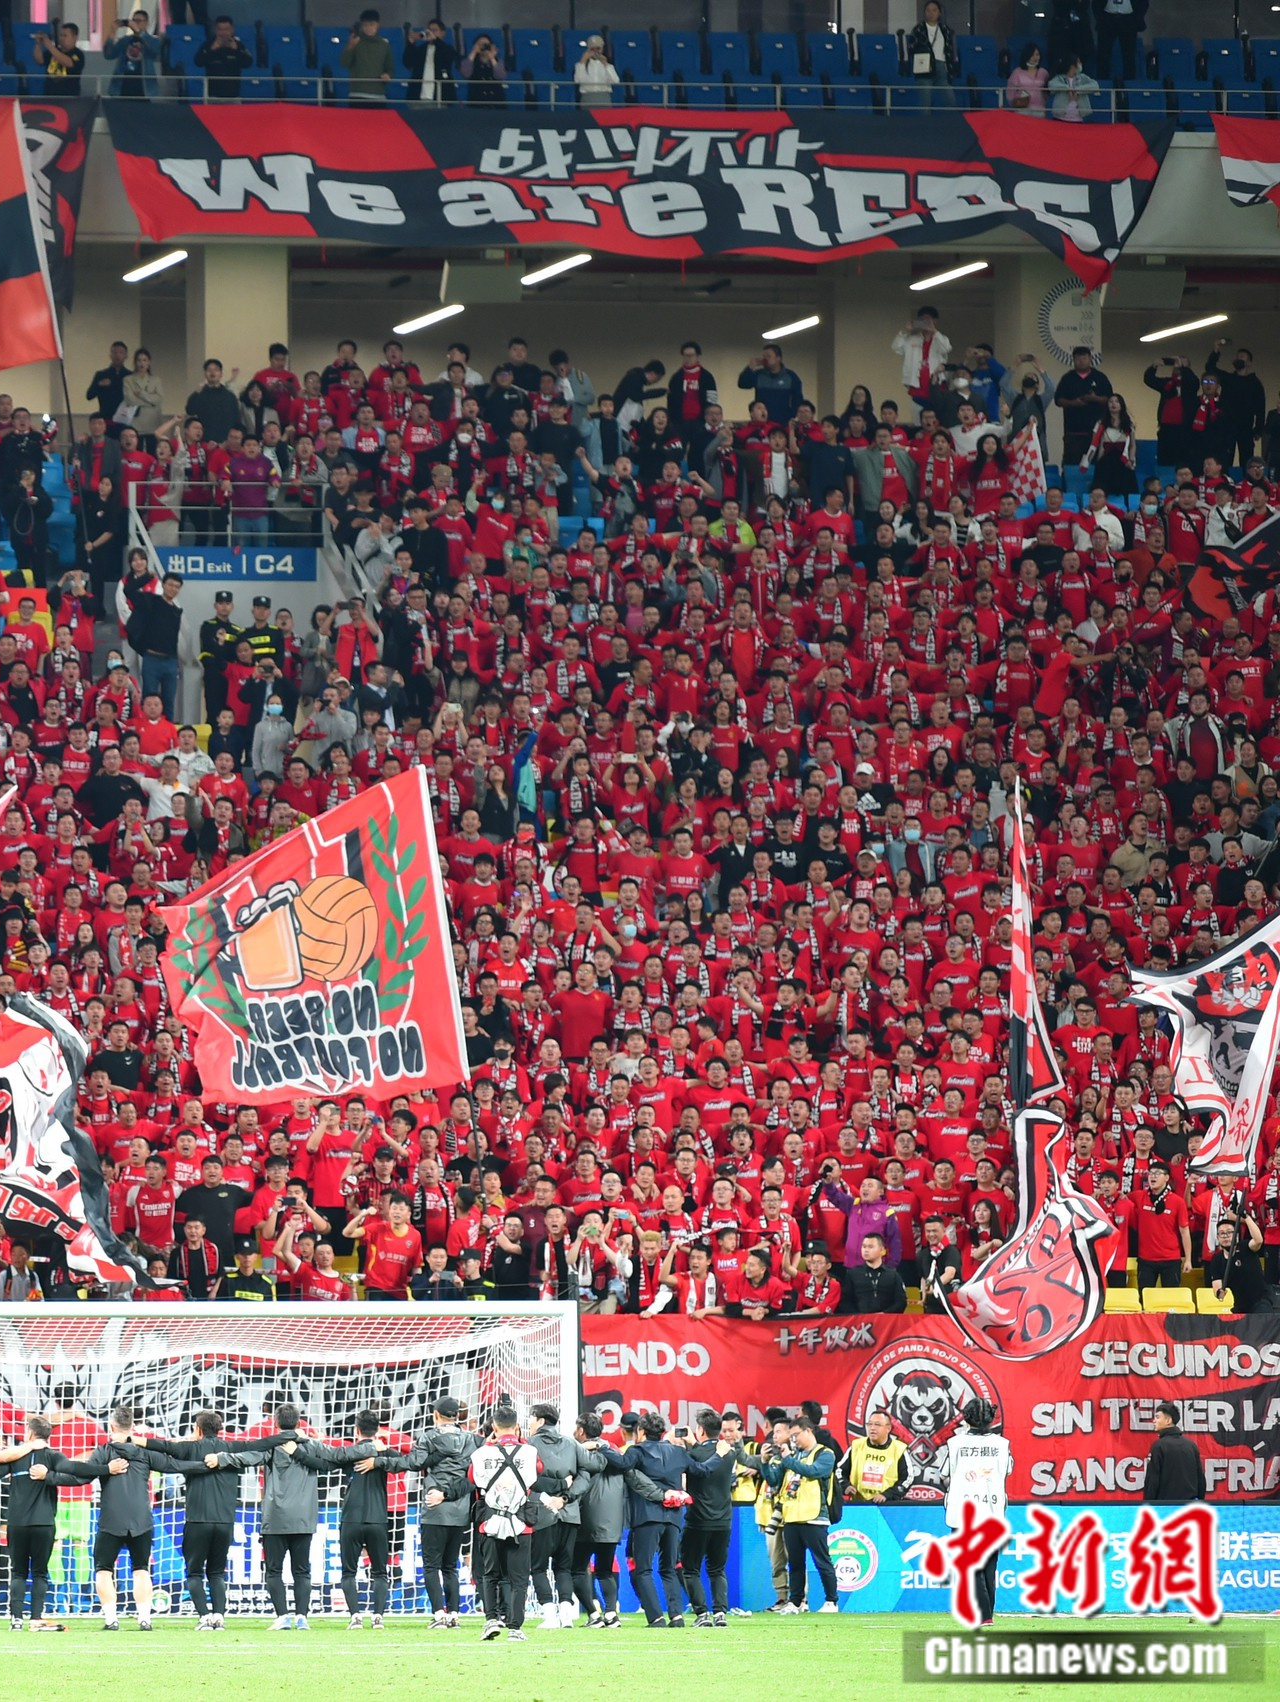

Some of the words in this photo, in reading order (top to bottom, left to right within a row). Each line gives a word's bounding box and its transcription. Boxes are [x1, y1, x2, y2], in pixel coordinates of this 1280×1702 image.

[158, 152, 406, 226] We
[438, 180, 708, 238] are
[168, 554, 204, 574] 出口
[207, 561, 233, 573] Exit
[255, 554, 295, 574] C4
[140, 1201, 171, 1211] Emirates
[718, 1258, 738, 1268] NIKE
[773, 1322, 876, 1355] 十年饮冰
[581, 1340, 711, 1377] IENDO
[883, 1350, 896, 1364] DE
[897, 1344, 930, 1355] PANDA
[931, 1348, 959, 1364] ROJO
[959, 1360, 973, 1374] DE
[1080, 1341, 1280, 1378] SEGUIMOS
[1031, 1400, 1093, 1437] SIN
[1100, 1397, 1236, 1433] TEER
[484, 1458, 524, 1470] 官方影
[1030, 1456, 1145, 1496] SANG
[906, 1488, 937, 1499] 2006
[839, 1566, 856, 1574] CFA
